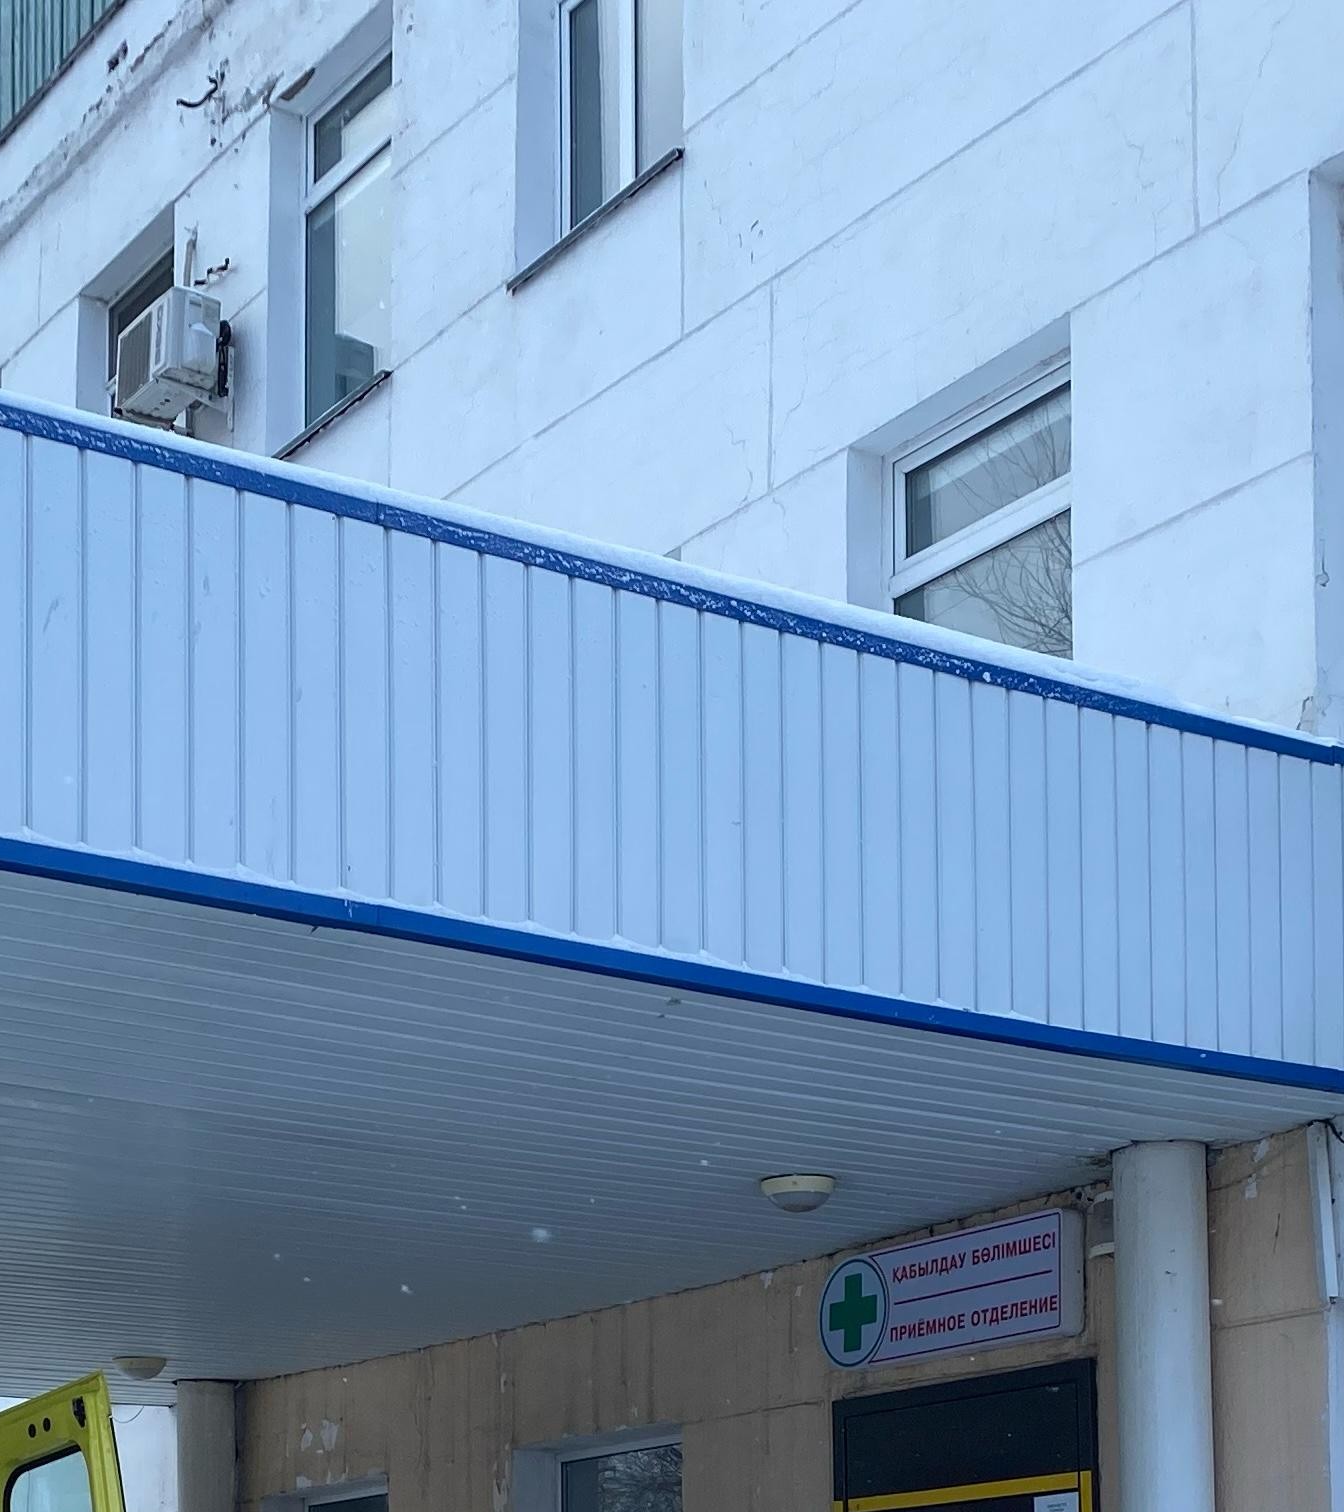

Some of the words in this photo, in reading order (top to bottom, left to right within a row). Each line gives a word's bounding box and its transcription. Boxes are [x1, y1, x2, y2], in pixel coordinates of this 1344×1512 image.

[892, 1252, 967, 1283] ҚАБЫЛДАУ
[971, 1231, 1056, 1266] БӨЛІМШЕСІ
[890, 1312, 966, 1343] ПРИЁМНОЕ
[971, 1295, 1058, 1327] ОТДЕЛЕНИЕ
